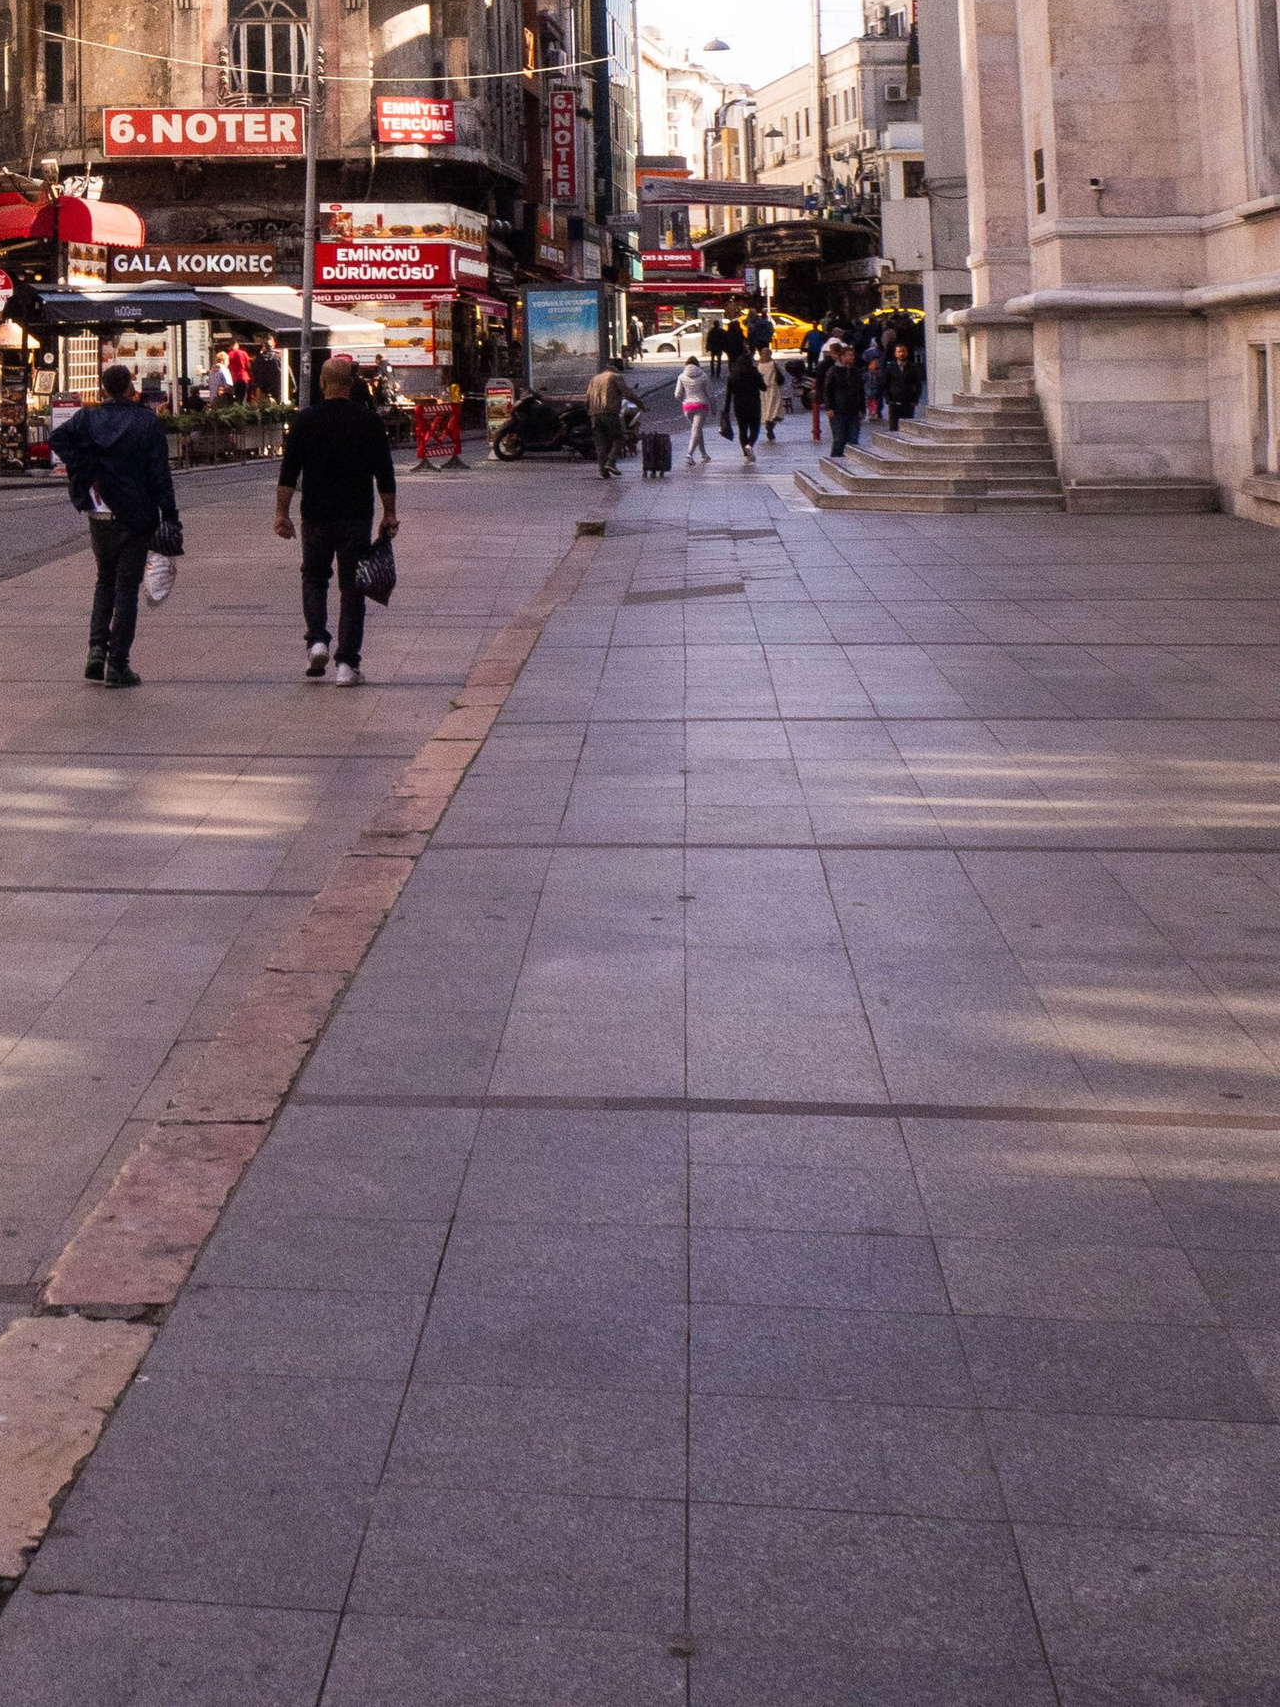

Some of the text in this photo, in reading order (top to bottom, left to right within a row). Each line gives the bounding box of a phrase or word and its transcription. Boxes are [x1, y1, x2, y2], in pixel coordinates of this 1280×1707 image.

[382, 100, 449, 116] EMNİYET
[381, 117, 454, 132] TERCÜME
[336, 246, 420, 261] EMİNÖNÜ
[113, 254, 273, 277] GALA KOKOREÇ
[333, 293, 397, 301] DÜRÜMCÜSÜ
